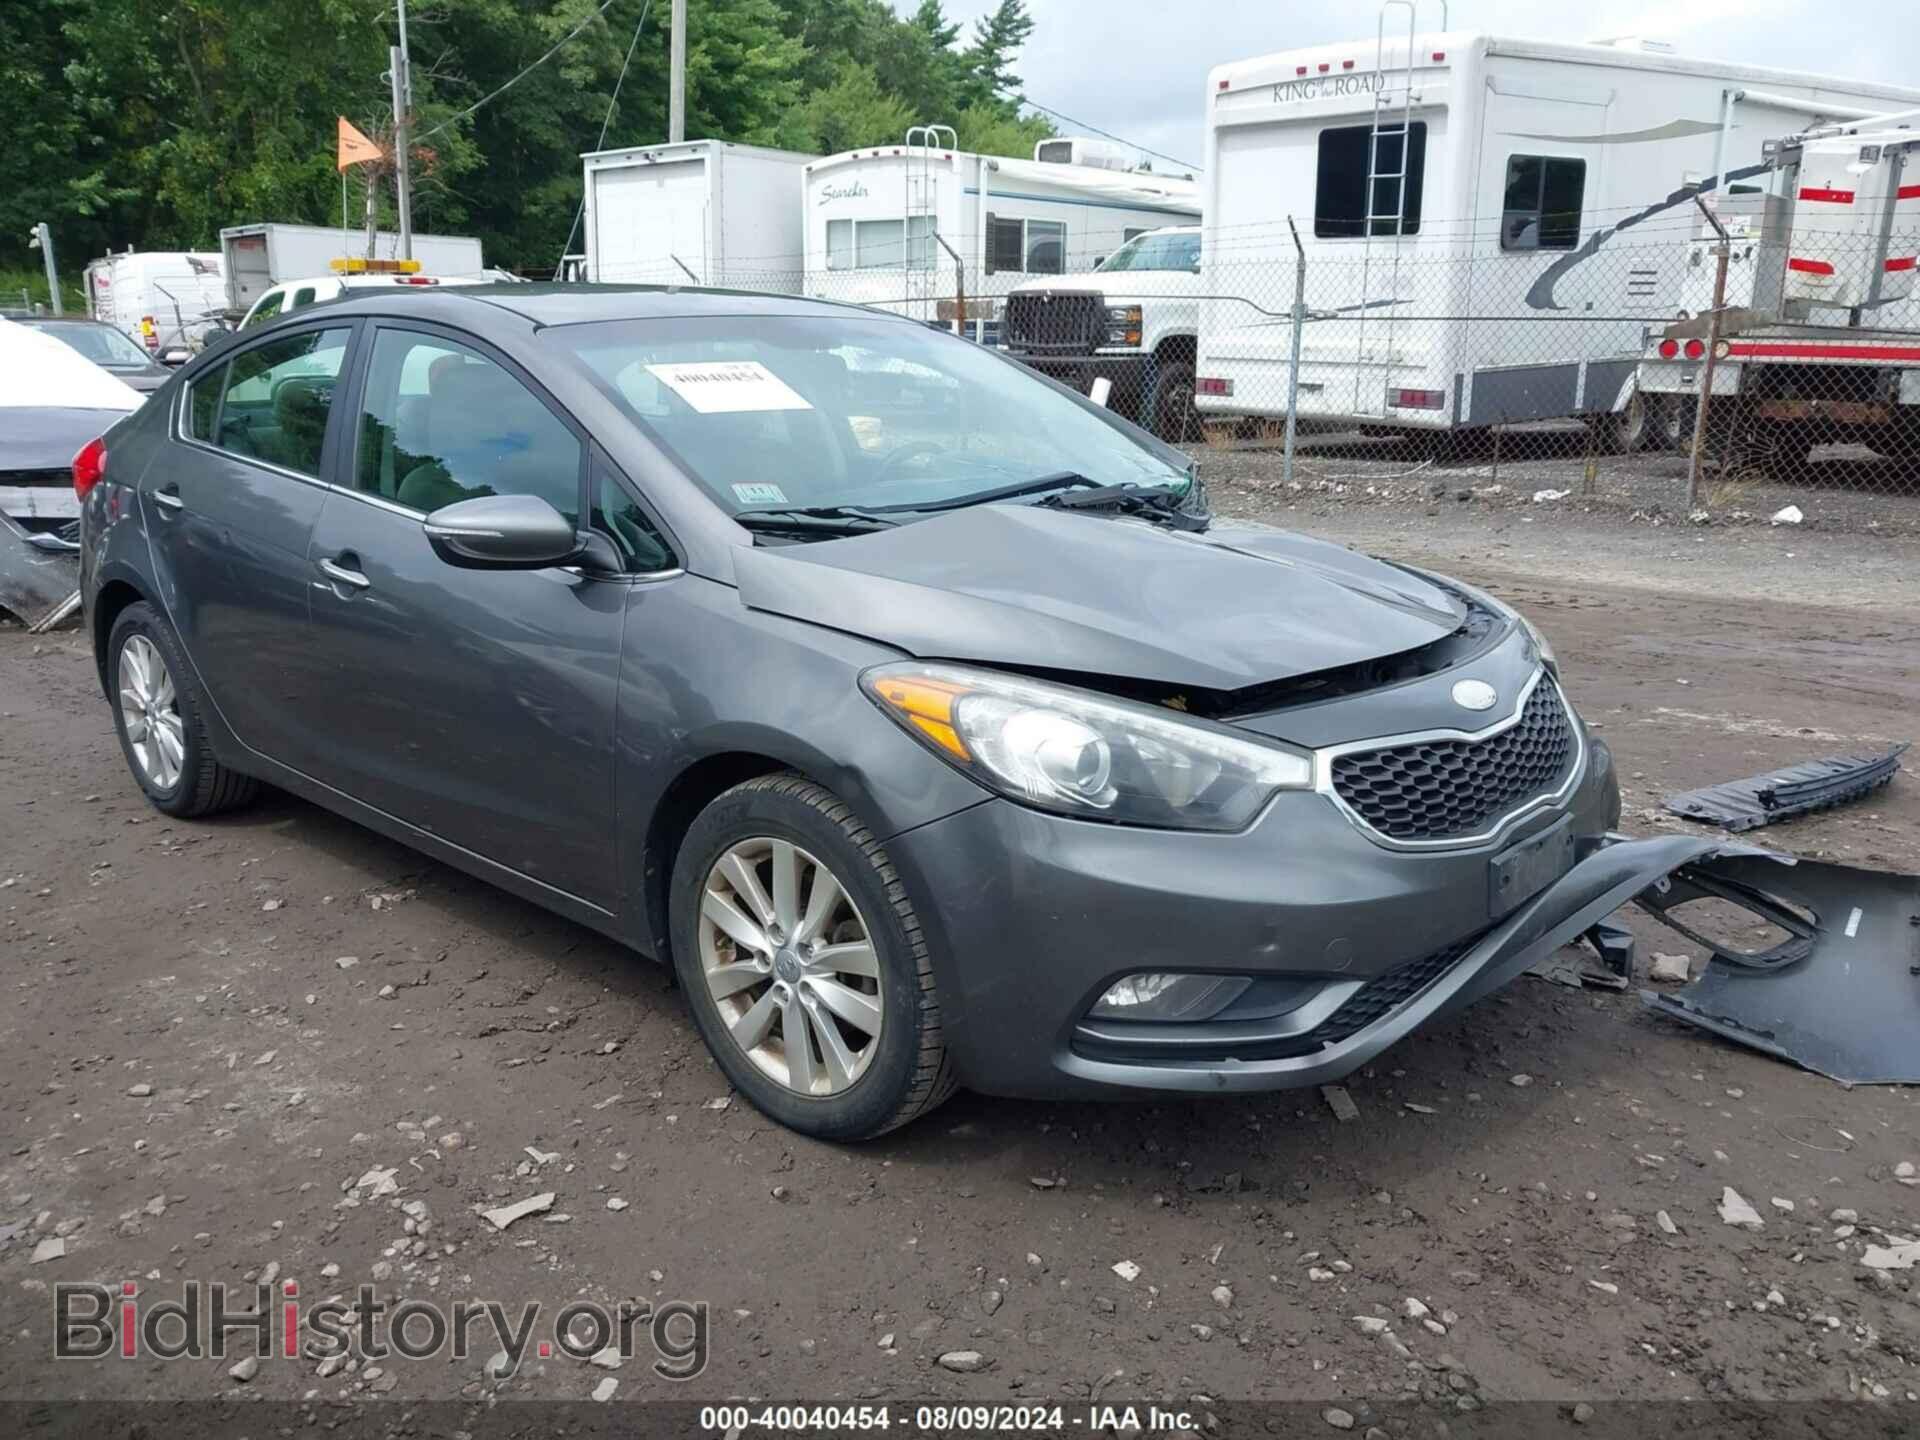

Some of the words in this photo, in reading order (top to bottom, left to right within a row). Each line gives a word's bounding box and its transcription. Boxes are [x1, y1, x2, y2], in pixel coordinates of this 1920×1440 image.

[1273, 81, 1315, 103] KING
[1335, 74, 1385, 97] ROAD
[818, 180, 868, 206] Searcher
